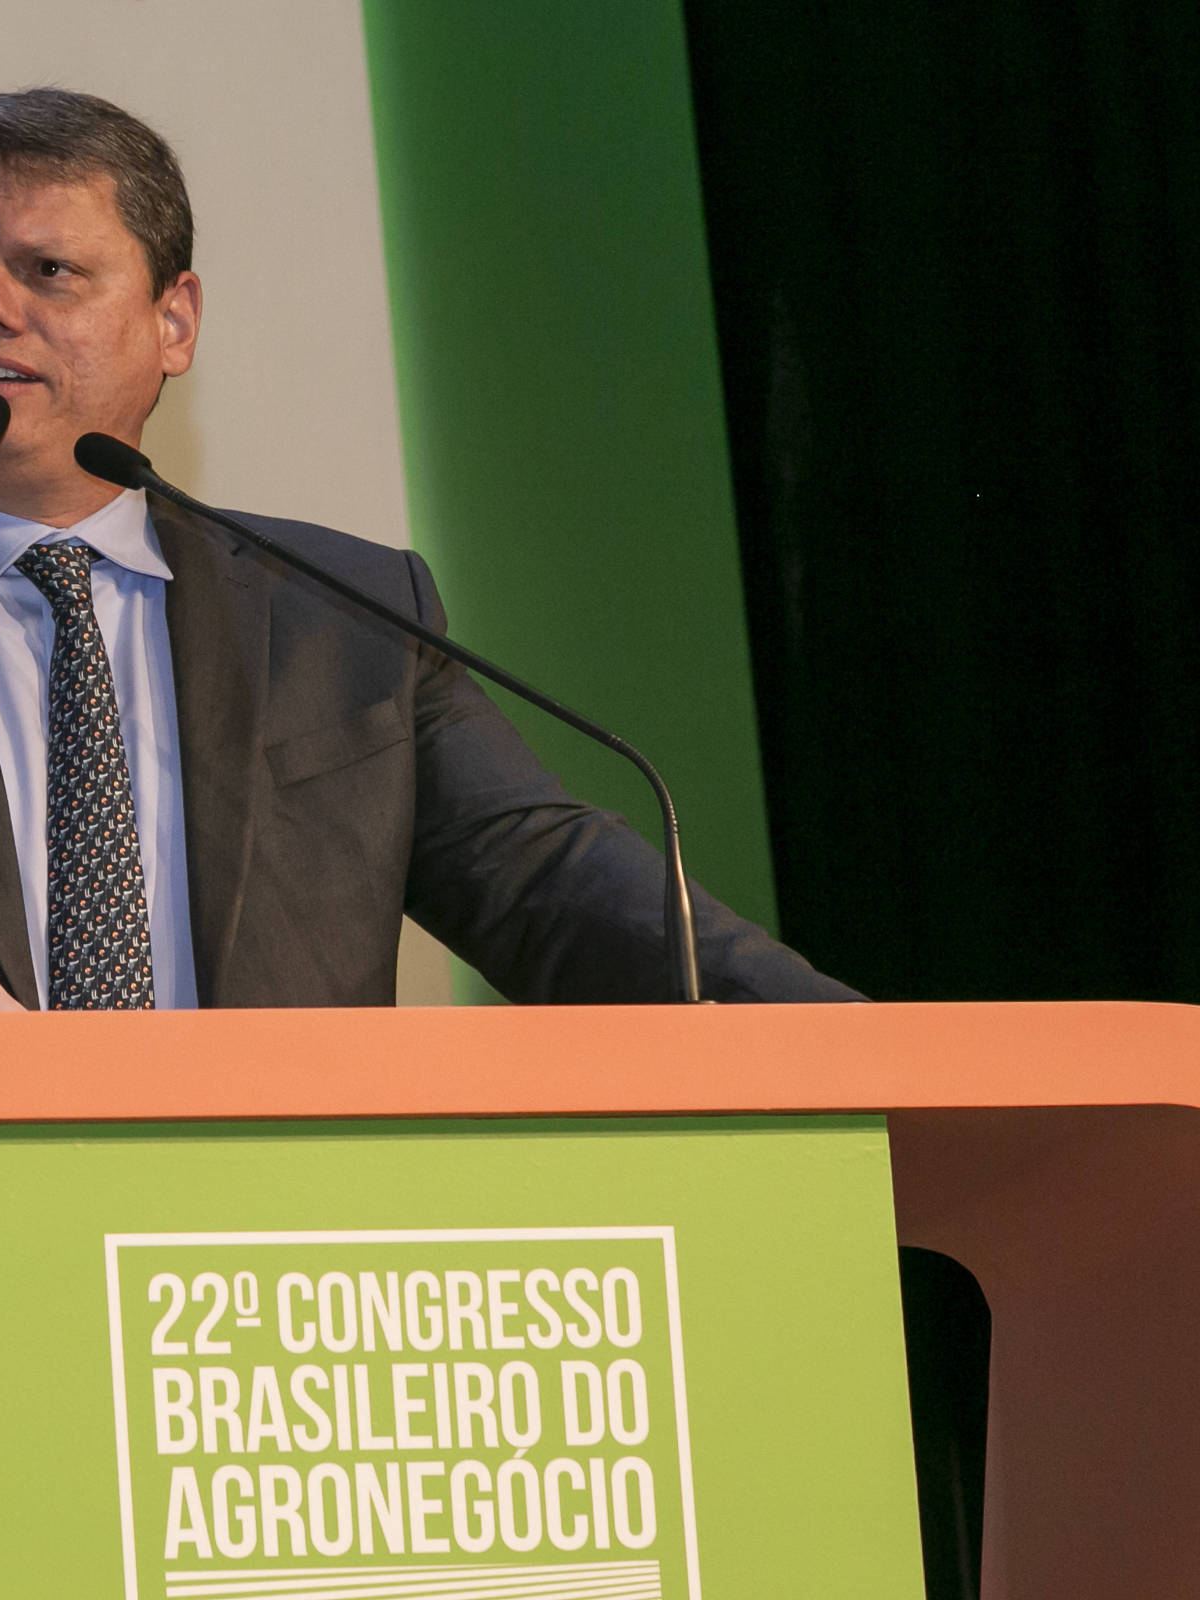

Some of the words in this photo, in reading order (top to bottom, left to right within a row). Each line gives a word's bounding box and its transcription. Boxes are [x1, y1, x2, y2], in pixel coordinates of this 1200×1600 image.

[277, 1267, 643, 1353] CONGRESSO
[152, 1359, 542, 1455] BRASILEIRO
[561, 1359, 650, 1447] DO
[164, 1447, 657, 1559] AGRONEGÓCIO
